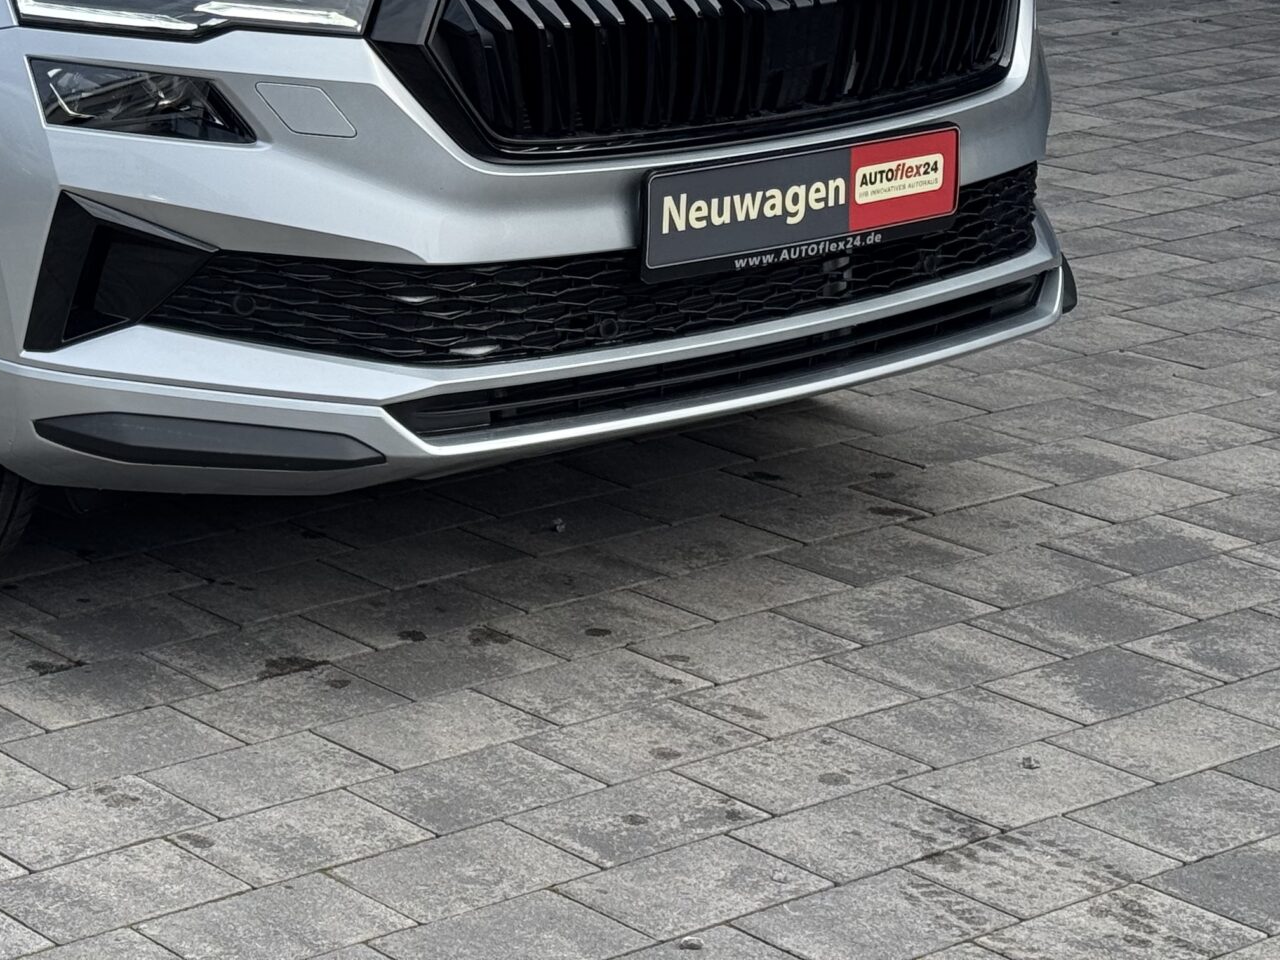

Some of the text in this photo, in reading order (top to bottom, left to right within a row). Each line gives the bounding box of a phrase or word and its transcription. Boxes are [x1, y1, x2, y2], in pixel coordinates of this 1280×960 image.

[860, 160, 939, 187] AUTOflex24
[662, 177, 846, 234] Neuwagen
[734, 232, 882, 270] www.AUTOflex24.de
